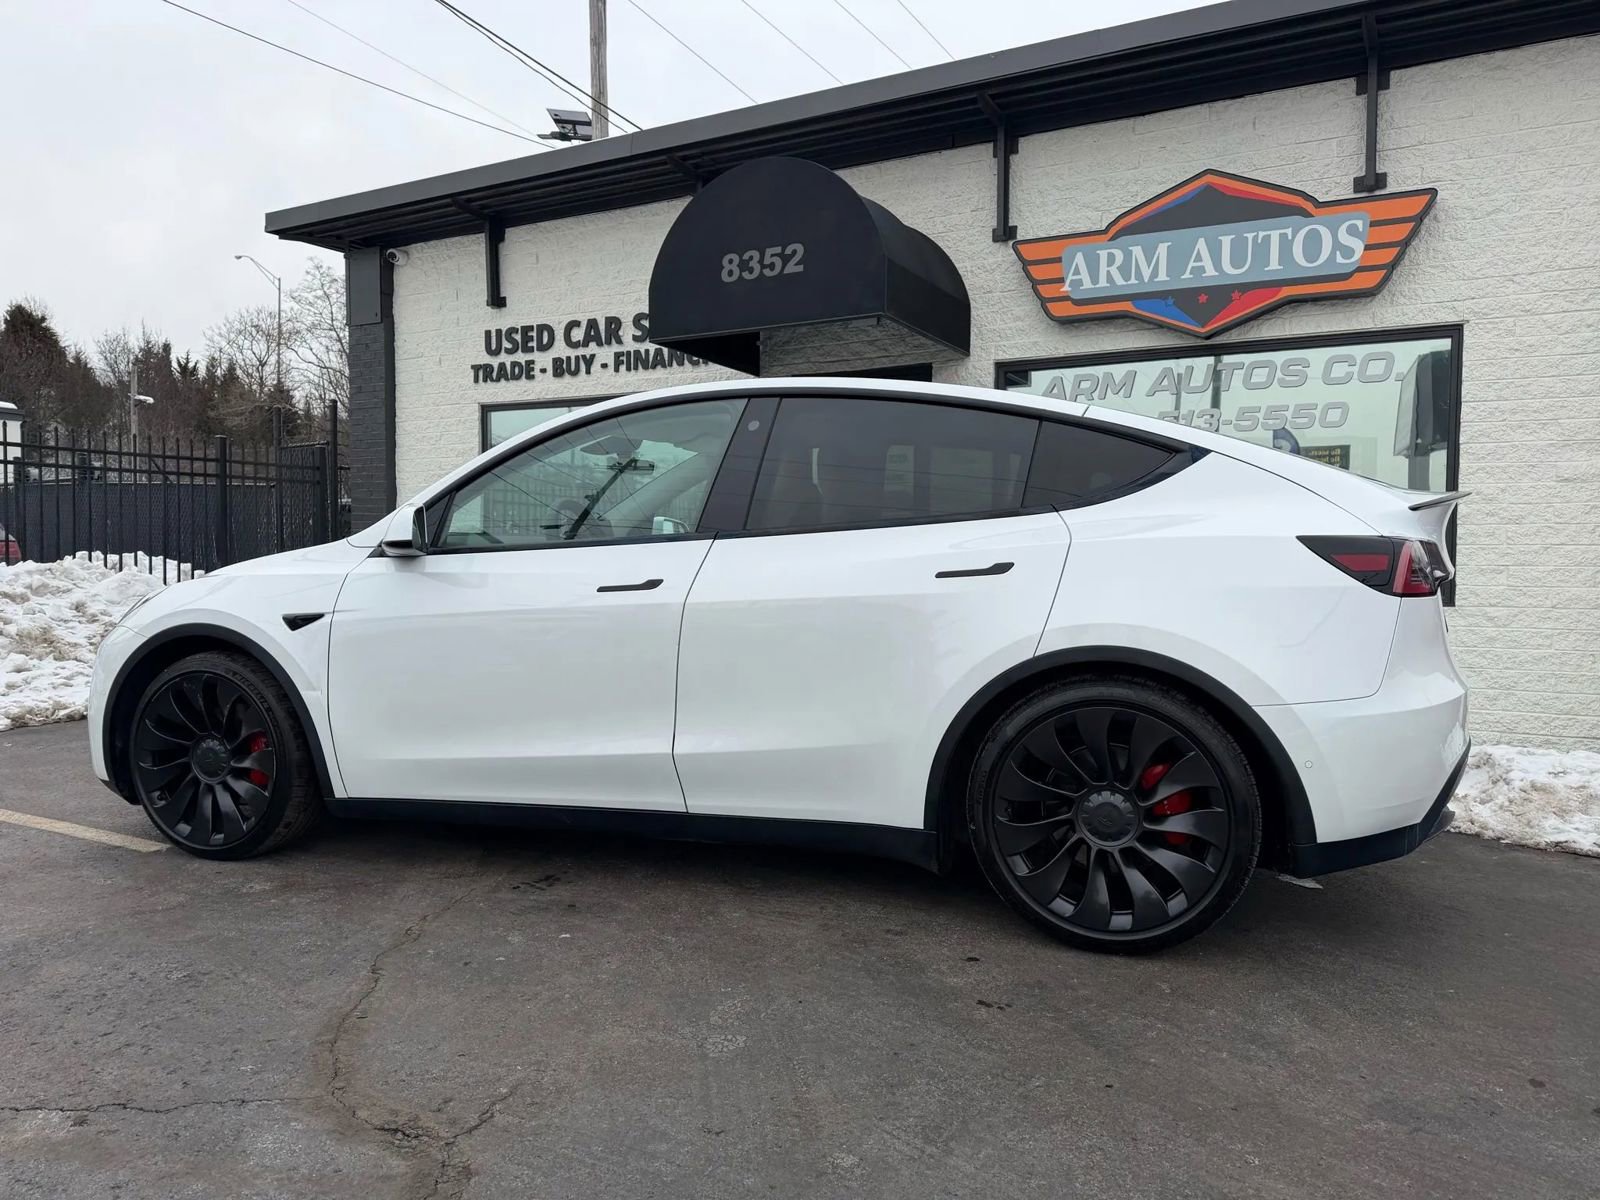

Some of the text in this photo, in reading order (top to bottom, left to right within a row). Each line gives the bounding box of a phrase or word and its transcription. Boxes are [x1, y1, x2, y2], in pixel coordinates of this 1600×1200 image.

[720, 242, 806, 284] 8352
[1061, 218, 1366, 292] ARM AUTOS
[484, 312, 650, 357] USED CAR S
[470, 360, 536, 384] TRADE
[552, 353, 597, 378] BUY
[613, 347, 709, 373] FINANC
[1040, 351, 1405, 403] ARM AUTOS CO.
